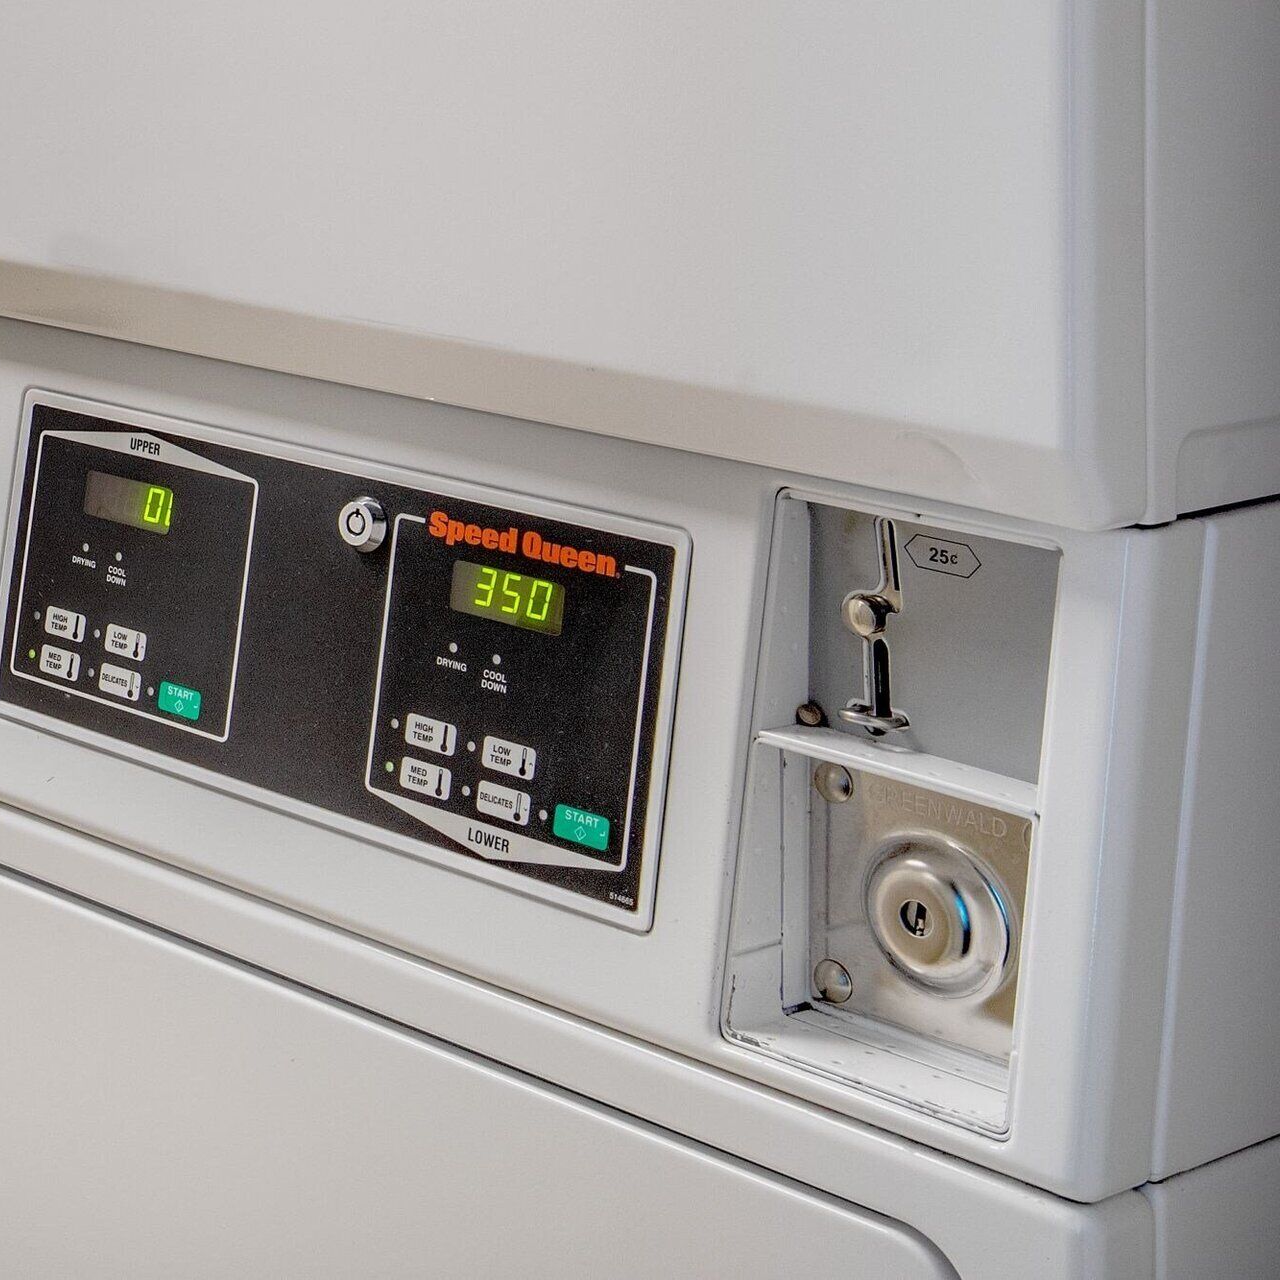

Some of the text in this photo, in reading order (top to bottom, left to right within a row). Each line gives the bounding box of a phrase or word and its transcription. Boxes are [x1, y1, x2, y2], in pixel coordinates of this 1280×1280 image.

[130, 437, 161, 456] UPPER
[428, 510, 617, 578] Speed Queen
[72, 555, 96, 569] DRYING
[928, 546, 959, 565] 25¢
[107, 565, 127, 578] COOL
[106, 574, 127, 587] DOWN
[474, 567, 553, 621] 350
[52, 612, 68, 624] HIGH
[50, 621, 68, 632] TEMP
[113, 630, 128, 641] LOW
[111, 639, 129, 650] TEMP
[48, 651, 62, 662] MED
[45, 660, 62, 671] TEMP
[436, 656, 467, 672] DRYING
[101, 672, 128, 688] DELICATES
[483, 669, 507, 683] COOL
[167, 685, 194, 702] START
[481, 679, 507, 694] DOWN
[414, 721, 434, 734] HIGH
[412, 730, 434, 744] TEMP
[492, 744, 512, 757] LOW
[490, 753, 512, 767] TEMP
[410, 765, 428, 777] MED
[407, 774, 429, 788] TEMP
[479, 792, 513, 810] DELICATES
[564, 809, 600, 829] START
[467, 826, 510, 854] LOWER
